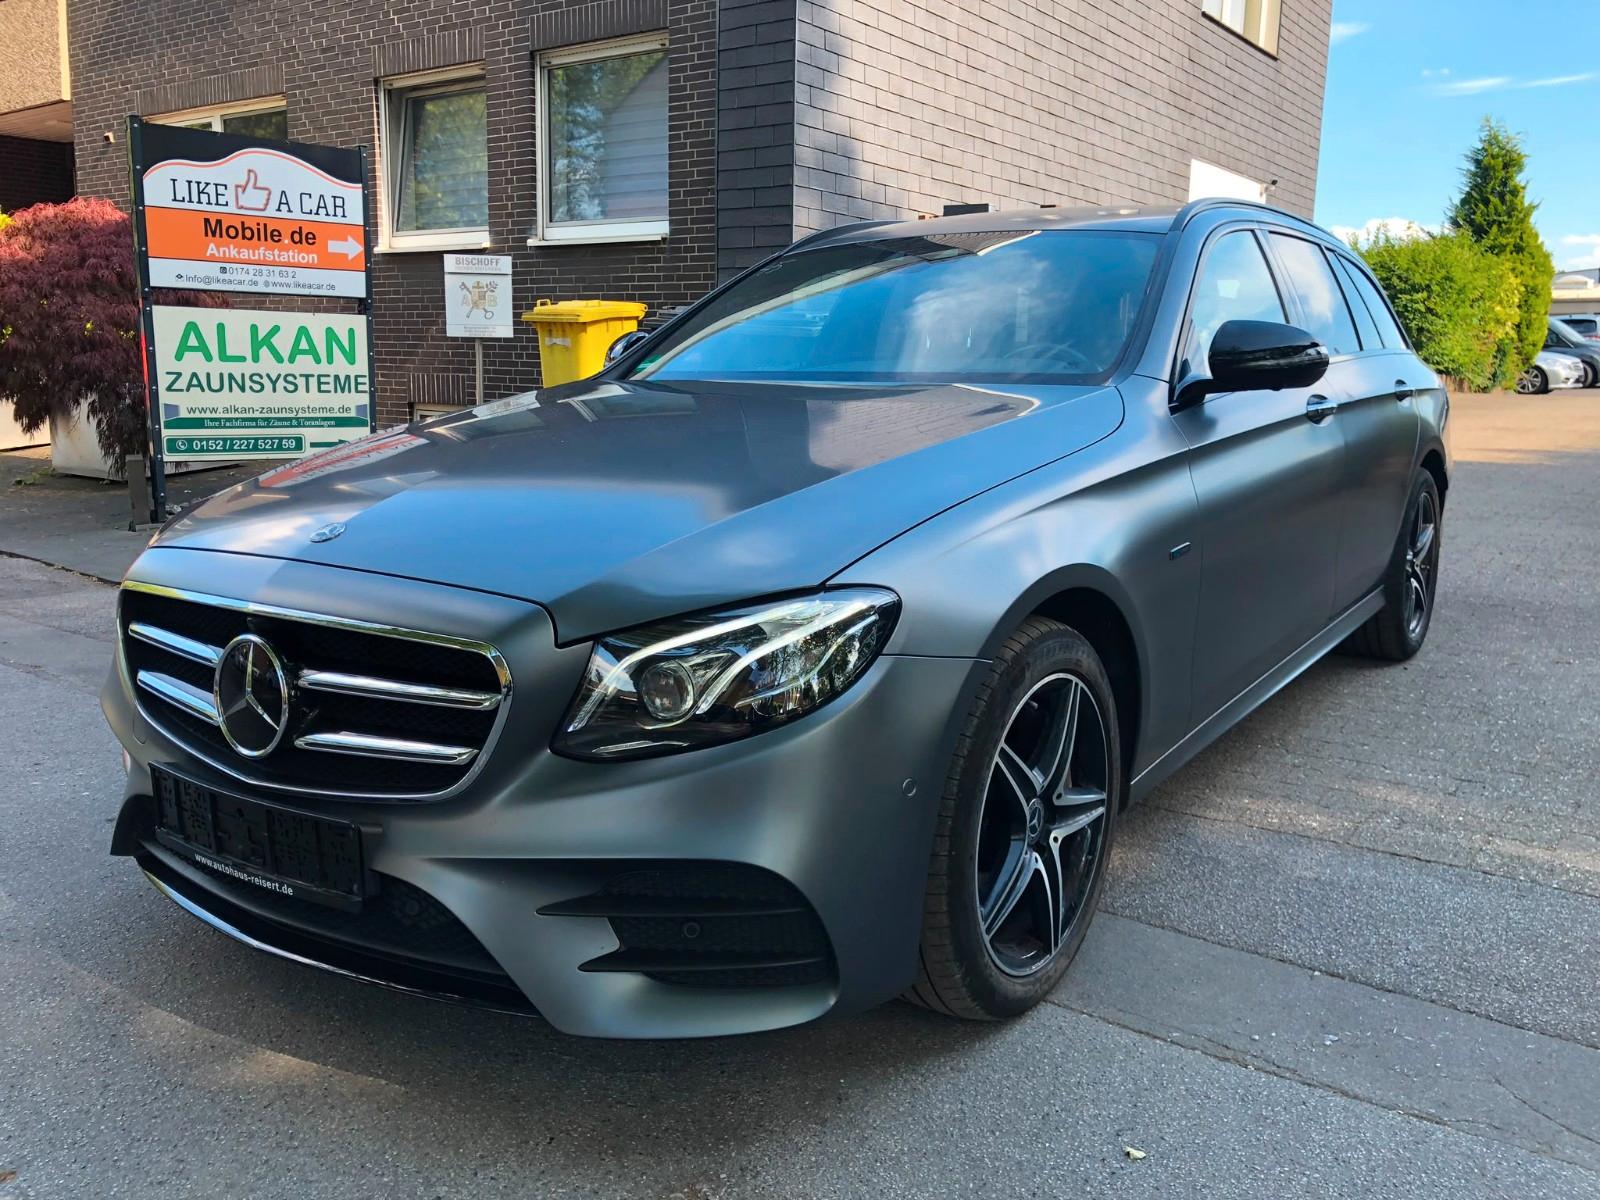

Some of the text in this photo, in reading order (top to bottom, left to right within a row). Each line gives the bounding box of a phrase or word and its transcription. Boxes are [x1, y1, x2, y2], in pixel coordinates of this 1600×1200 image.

[169, 178, 348, 219] LIKE A CAR
[203, 217, 317, 246] Mobile.de
[206, 243, 318, 265] Ankaufstation
[455, 256, 501, 266] BISCHOFF
[228, 266, 297, 279] 0174 28 31 63 2
[184, 274, 336, 291] Info@likeacar.de www.likeacar.de
[174, 320, 357, 366] ALKAN
[165, 371, 369, 394] ZAUNSYSTEME
[186, 404, 352, 417] www.alkan-zaunsysteme.de
[204, 419, 220, 427] Ihre
[221, 419, 256, 427] Fachfirma
[257, 419, 268, 427] für
[299, 418, 336, 427] Toranlagen
[193, 440, 224, 451] 0152
[232, 439, 256, 450] 227
[258, 439, 281, 449] 527
[282, 438, 296, 449] 59
[195, 852, 294, 896] www.autohaus-reisert.de
